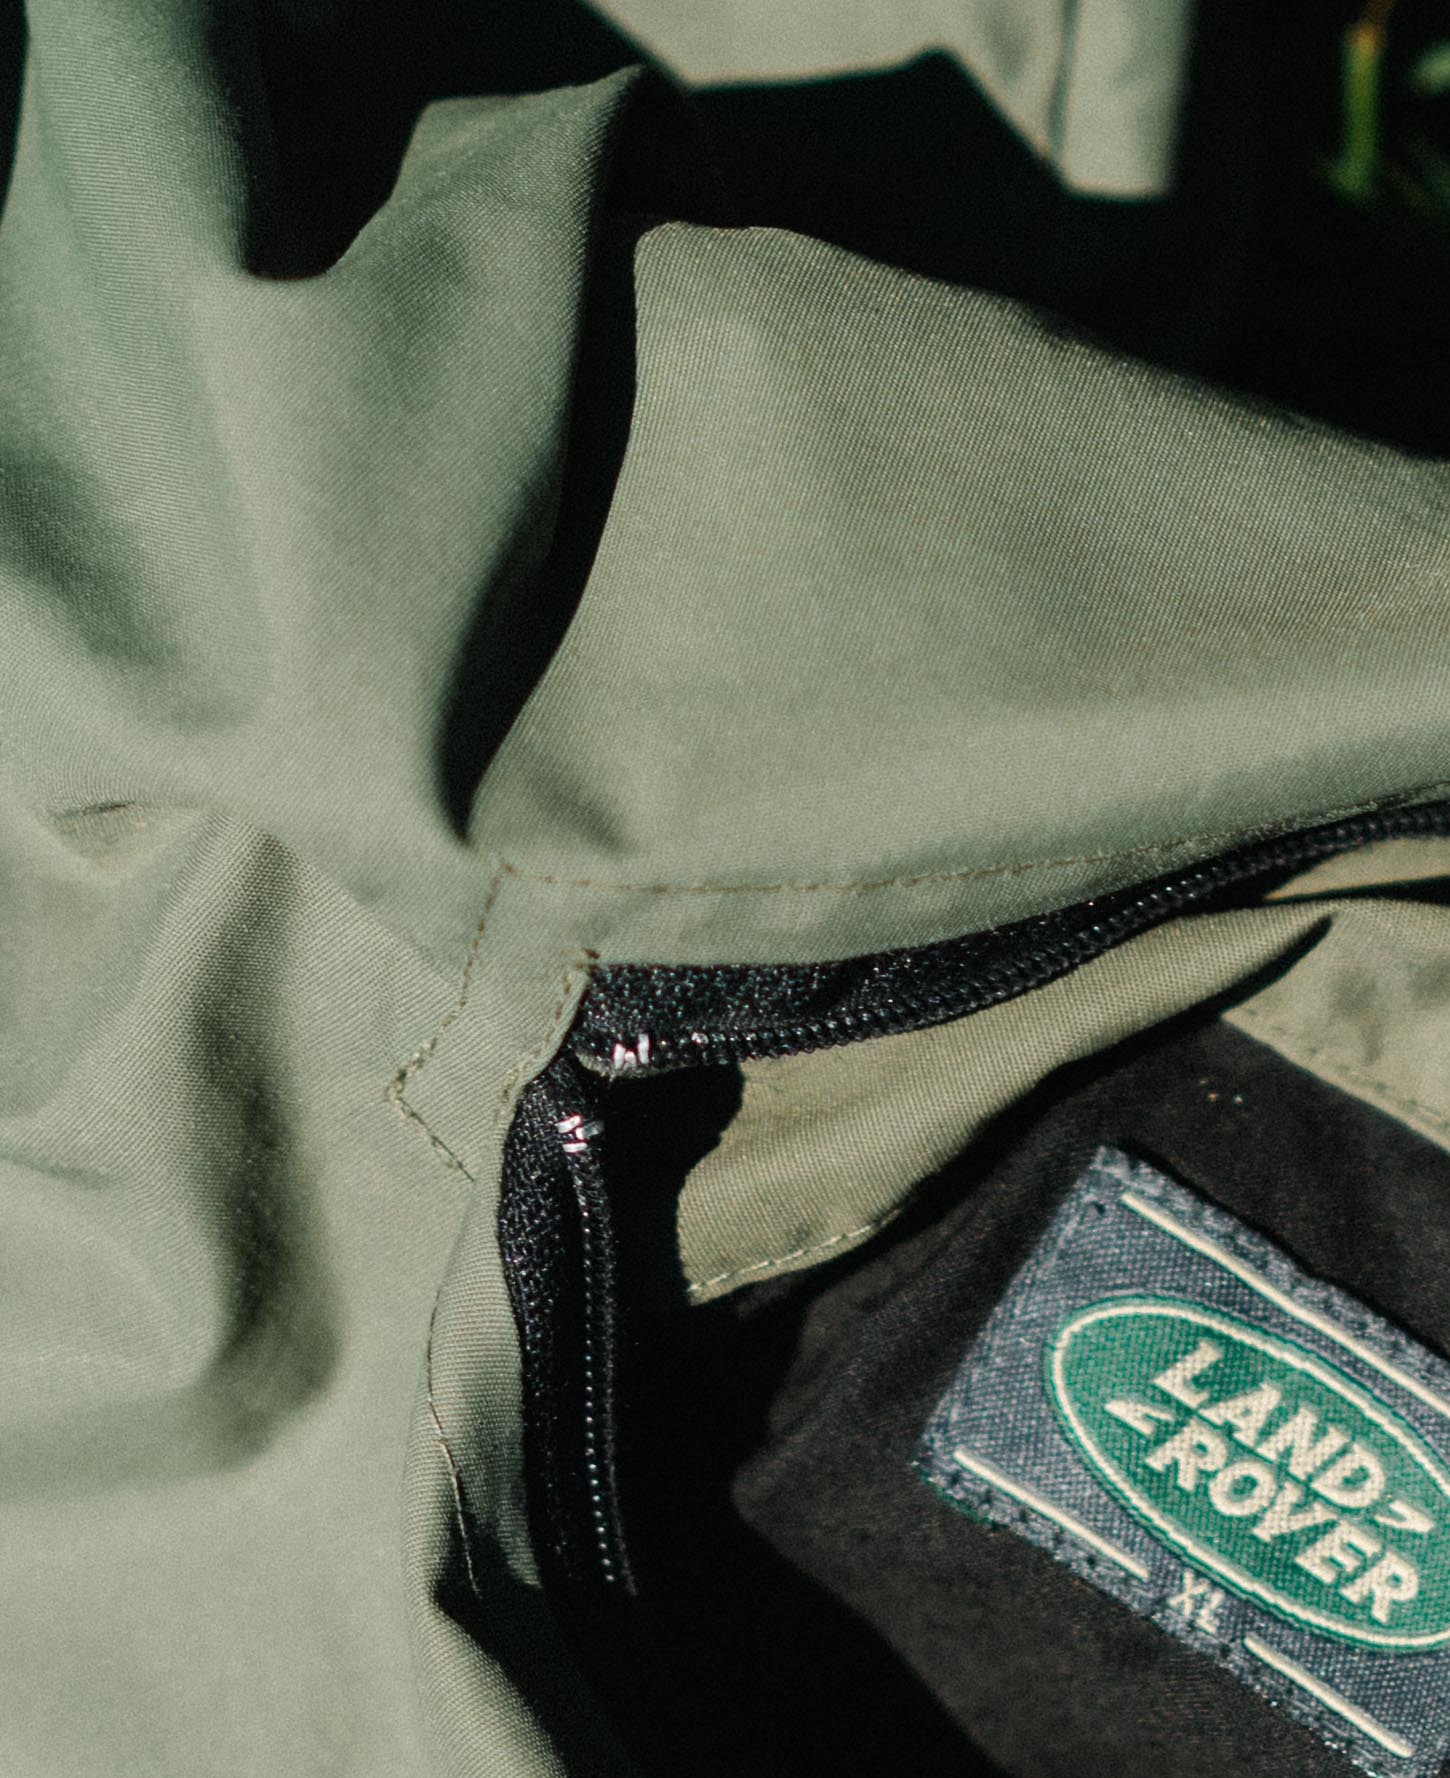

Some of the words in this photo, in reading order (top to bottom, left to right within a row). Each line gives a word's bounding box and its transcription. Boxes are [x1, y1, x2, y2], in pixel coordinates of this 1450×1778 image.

[1153, 1341, 1387, 1508] LAND
[1146, 1427, 1420, 1625] ROVER
[1167, 1569, 1224, 1634] XL
